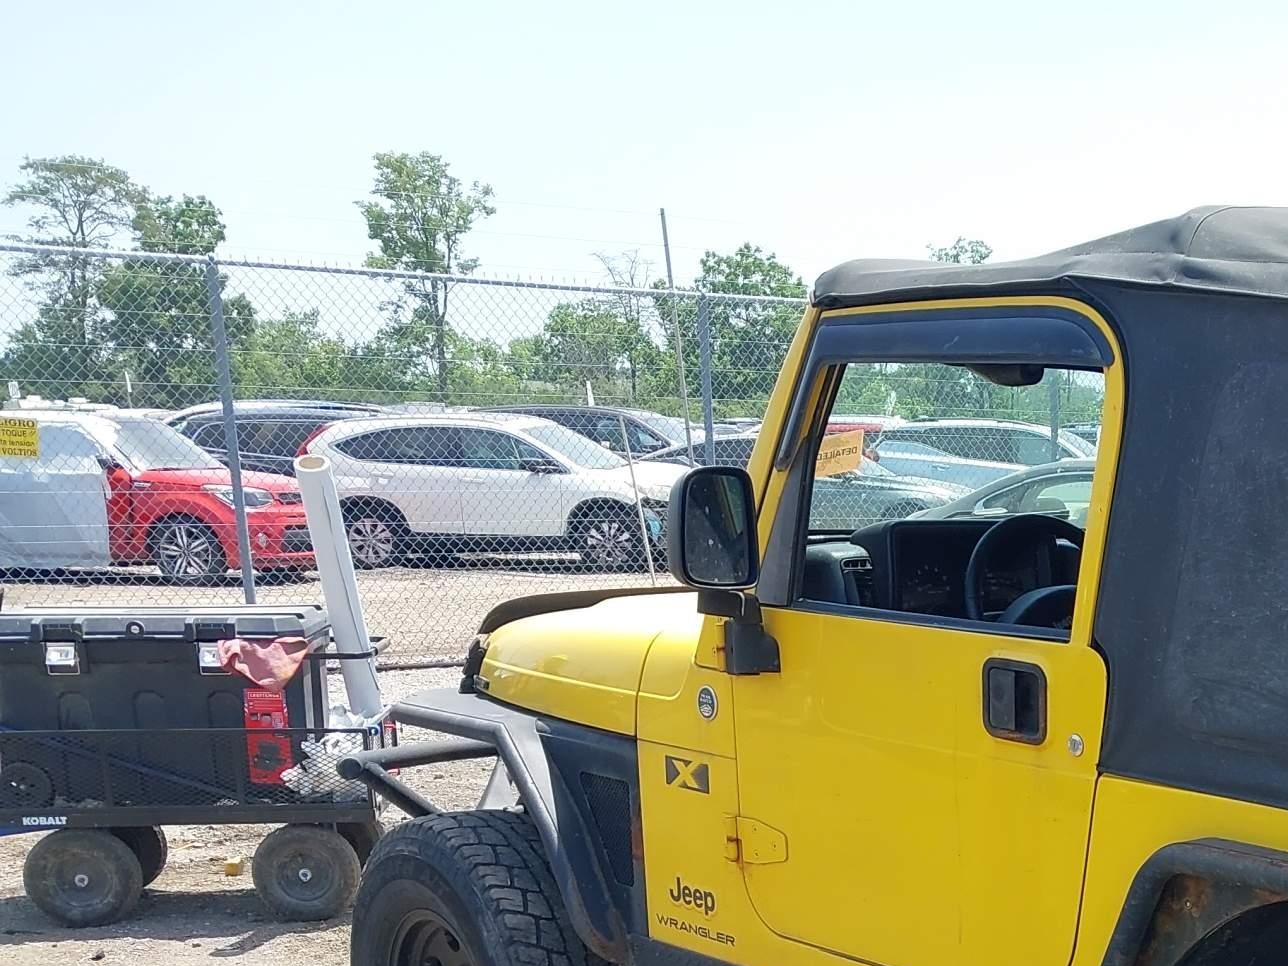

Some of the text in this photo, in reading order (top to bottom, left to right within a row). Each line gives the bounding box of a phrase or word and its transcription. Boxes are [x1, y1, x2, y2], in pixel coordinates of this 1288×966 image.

[2, 429, 27, 437] TOQUE
[2, 447, 37, 457] VOLTIOS
[22, 816, 67, 825] KOBALT
[669, 876, 715, 916] Jeep
[656, 912, 736, 947] WRANGLER
